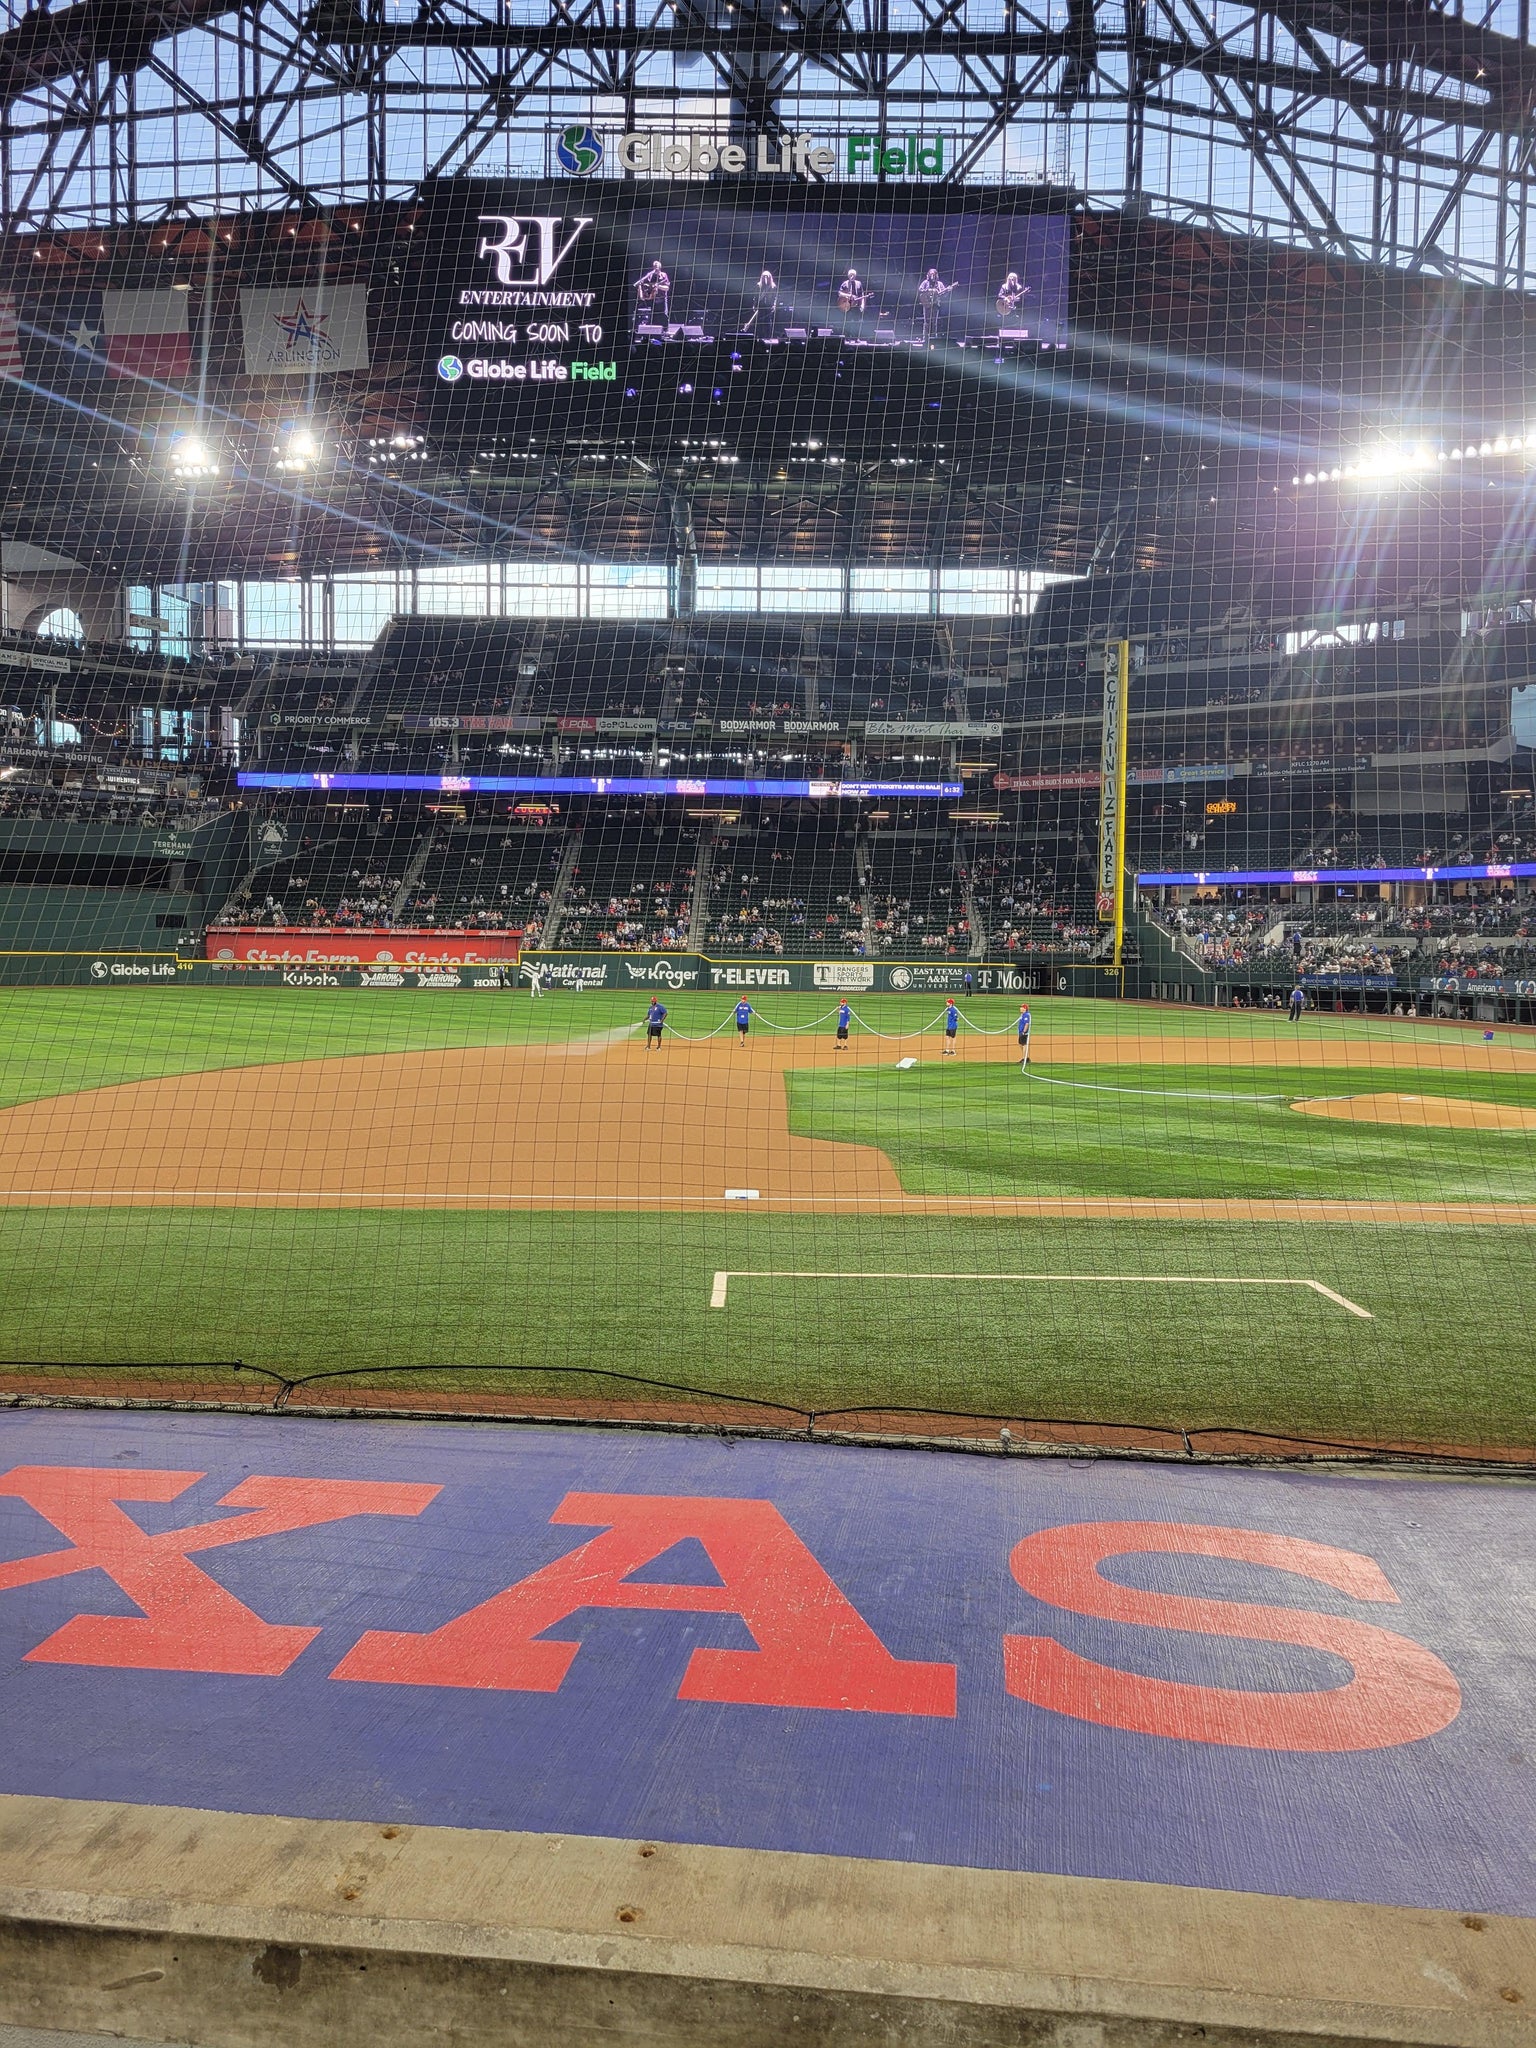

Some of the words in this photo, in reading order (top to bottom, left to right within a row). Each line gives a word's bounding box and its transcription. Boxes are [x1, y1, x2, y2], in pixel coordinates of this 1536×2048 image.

[618, 133, 747, 173] Globe
[757, 133, 836, 174] Life
[847, 134, 944, 176] Field
[459, 290, 595, 307] ENTERTAINMENT
[452, 321, 517, 343] COMING
[526, 323, 569, 342] SOON
[579, 324, 602, 343] TO
[266, 349, 341, 363] ARLINGTON
[467, 360, 526, 379] Globe
[530, 360, 568, 380] Life
[571, 361, 617, 381] Field
[285, 715, 322, 725] PRIORITY
[324, 716, 371, 725] COMMERCE
[428, 717, 460, 728] 105.3
[463, 717, 486, 729] THE
[488, 717, 514, 729] FAN
[600, 720, 653, 730] GoPGL.com
[720, 720, 776, 730] BODYARMOR
[783, 721, 840, 731] BODYARMOR
[867, 722, 896, 735] Blue
[900, 723, 933, 734] Mint
[938, 723, 964, 735] Thai
[1105, 679, 1117, 773] CHIKIN
[0, 746, 49, 758] HARGROVE
[65, 752, 103, 764] ROOFING
[1180, 769, 1198, 778] Great
[1199, 768, 1225, 776] Service
[1032, 779, 1044, 787] THIS
[1074, 777, 1086, 785] YOU
[1104, 781, 1116, 811] IZ
[1206, 801, 1237, 809] GOLDEN
[152, 840, 192, 849] TEREMANA
[1103, 820, 1115, 886] FARE
[111, 963, 150, 976] Globe
[152, 963, 176, 976] Life
[648, 961, 699, 989] Kroger
[1104, 968, 1119, 976] 326
[372, 973, 399, 982] ARROW
[428, 974, 456, 982] ARROW
[927, 975, 949, 983] A&M
[1466, 982, 1496, 992] American
